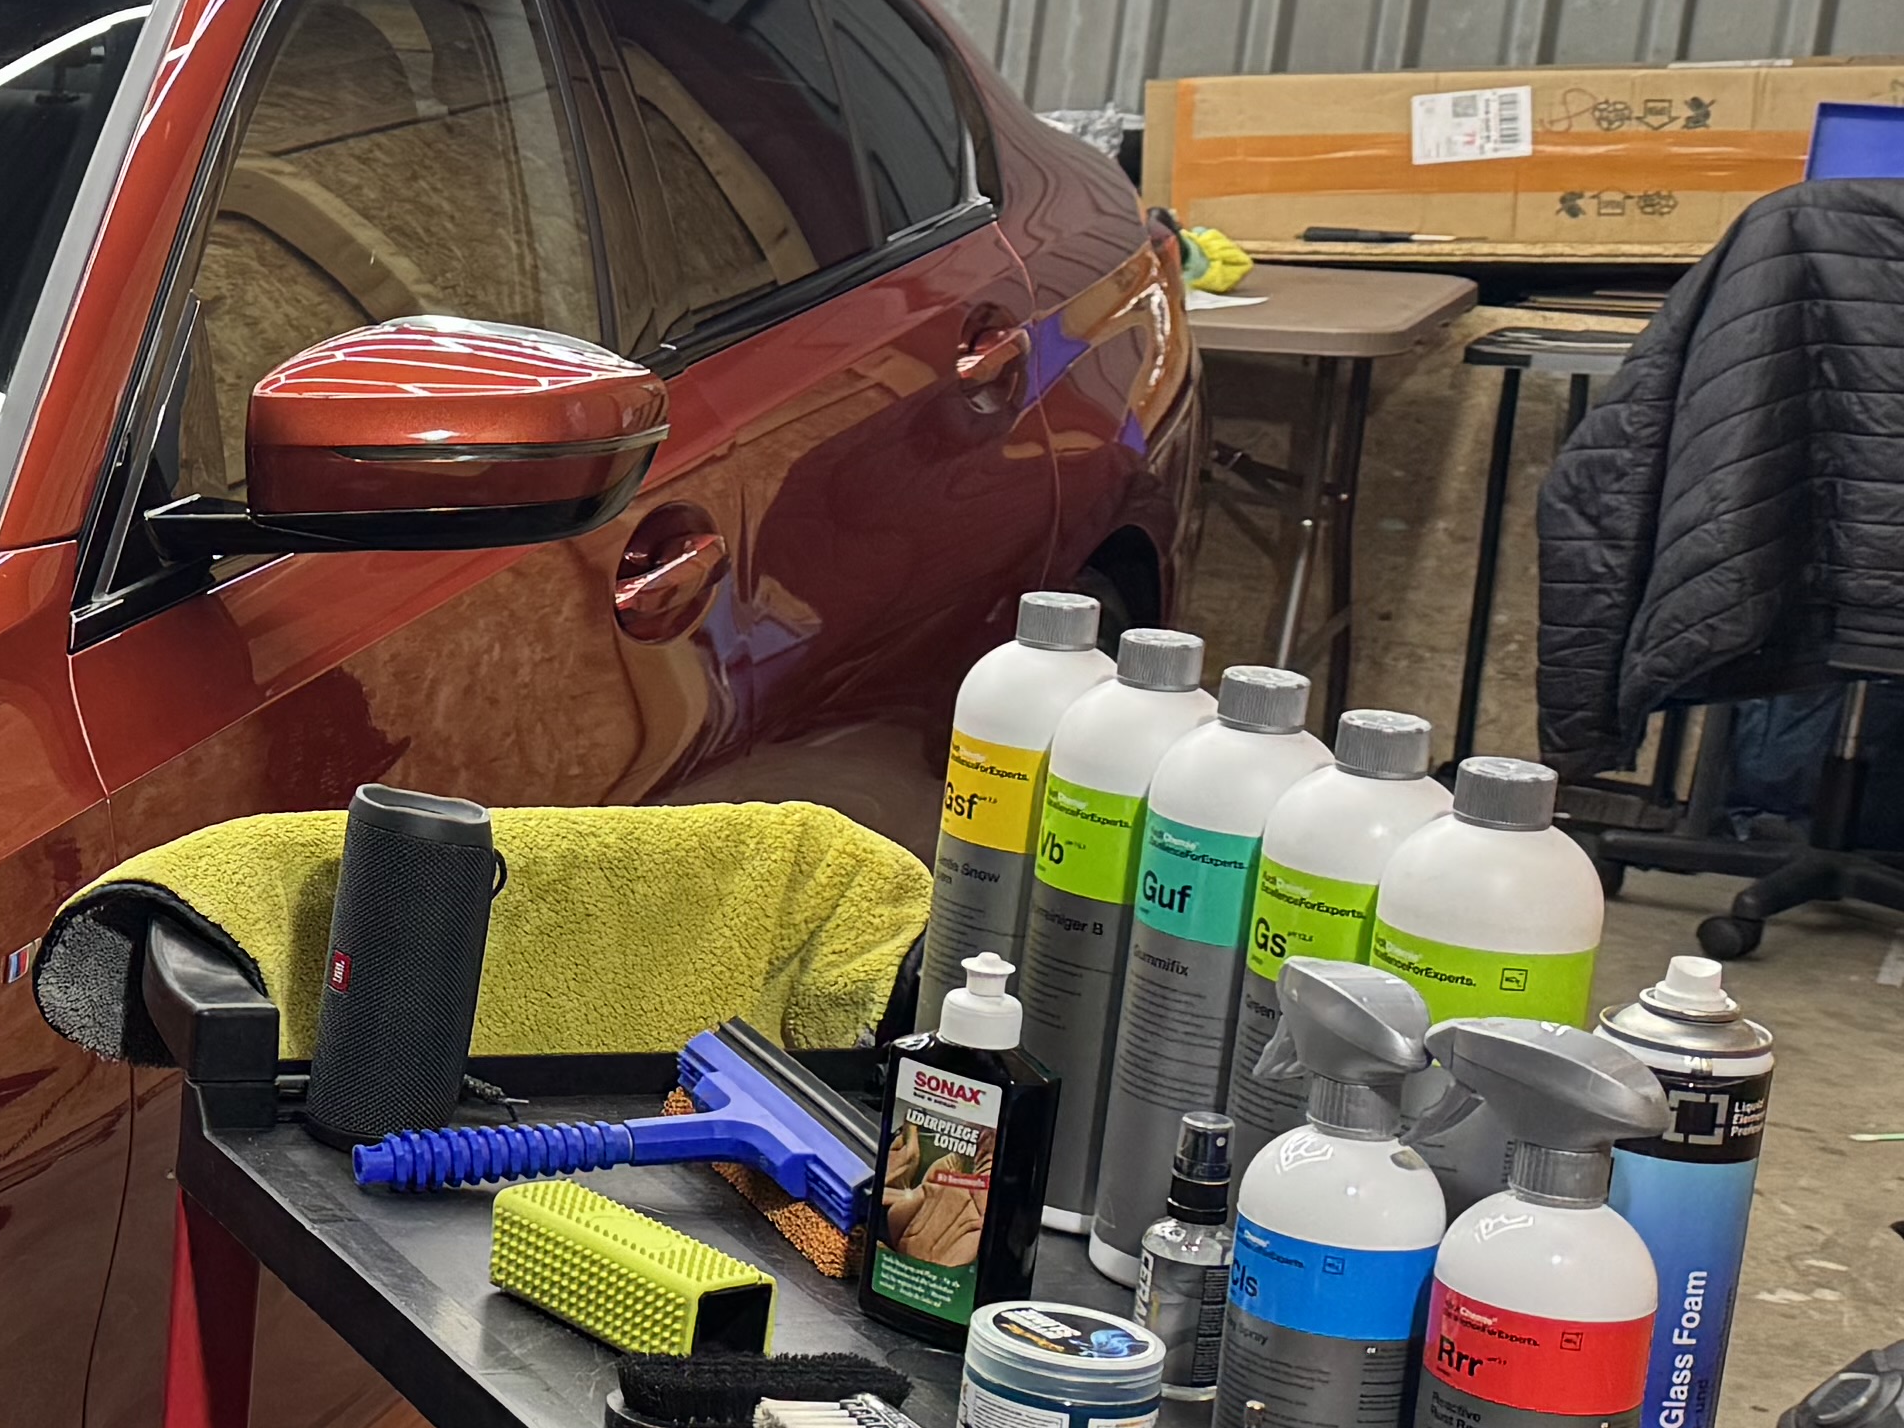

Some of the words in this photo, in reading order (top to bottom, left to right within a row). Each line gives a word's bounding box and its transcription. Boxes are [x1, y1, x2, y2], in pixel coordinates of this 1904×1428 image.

[960, 862, 1001, 884] Snow
[1143, 869, 1193, 914] Guf
[1255, 916, 1288, 958] Gs
[914, 1071, 981, 1106] SONAX
[906, 1108, 980, 1144] LEDERPFLEGE
[933, 1132, 978, 1158] LOTION
[1232, 1257, 1259, 1298] Cls
[1672, 1270, 1708, 1346] Foam
[1438, 1334, 1484, 1377] Rrr
